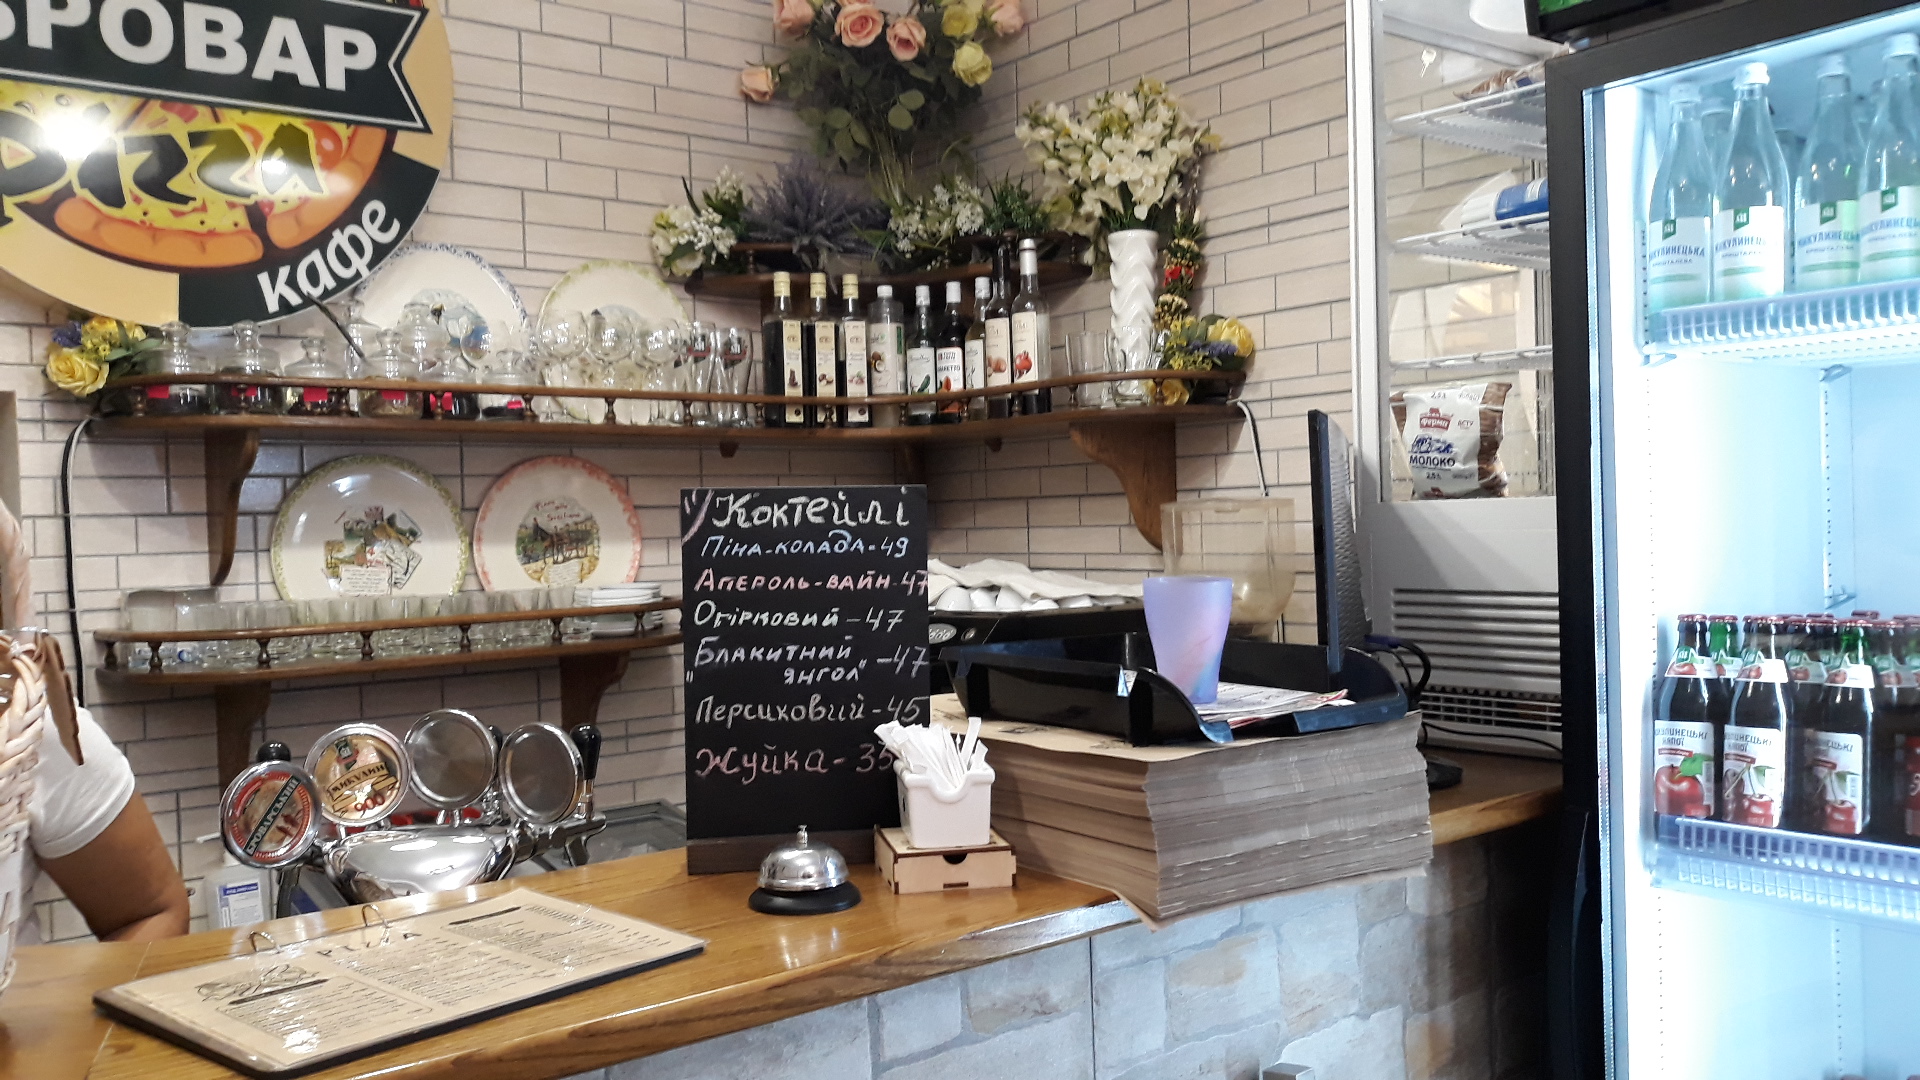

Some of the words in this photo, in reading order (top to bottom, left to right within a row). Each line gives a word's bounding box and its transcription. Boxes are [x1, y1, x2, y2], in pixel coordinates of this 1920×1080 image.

[0, 0, 377, 92] РОВАР
[257, 199, 400, 314] кафе
[1409, 455, 1456, 468] МОЛОКО
[711, 485, 910, 529] Коктейлі
